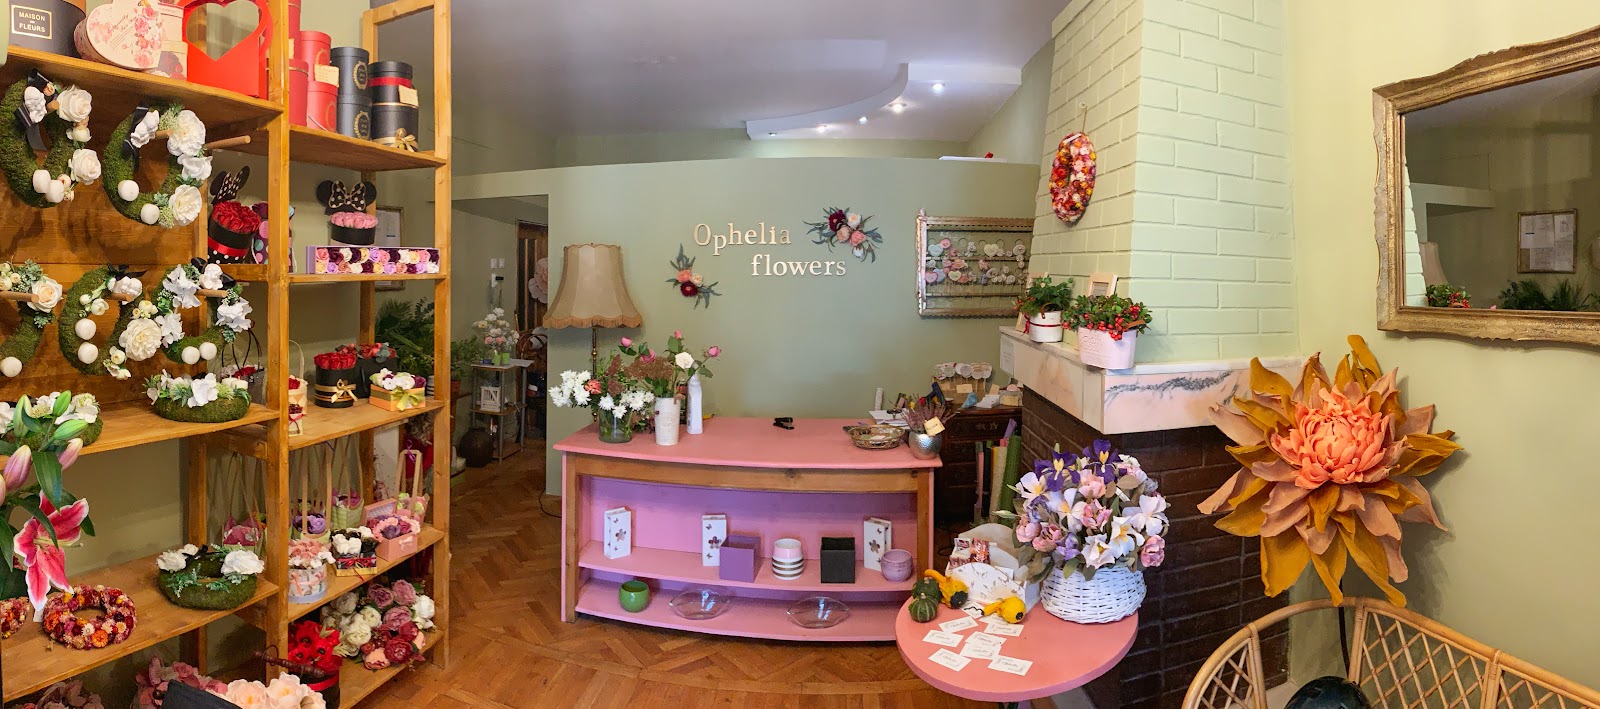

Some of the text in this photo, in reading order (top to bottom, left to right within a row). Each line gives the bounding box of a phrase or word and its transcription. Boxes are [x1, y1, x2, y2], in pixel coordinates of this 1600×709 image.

[19, 12, 45, 21] MAISON
[19, 23, 45, 32] FLEURS
[693, 222, 791, 256] Ophelia
[751, 254, 846, 276] flowers
